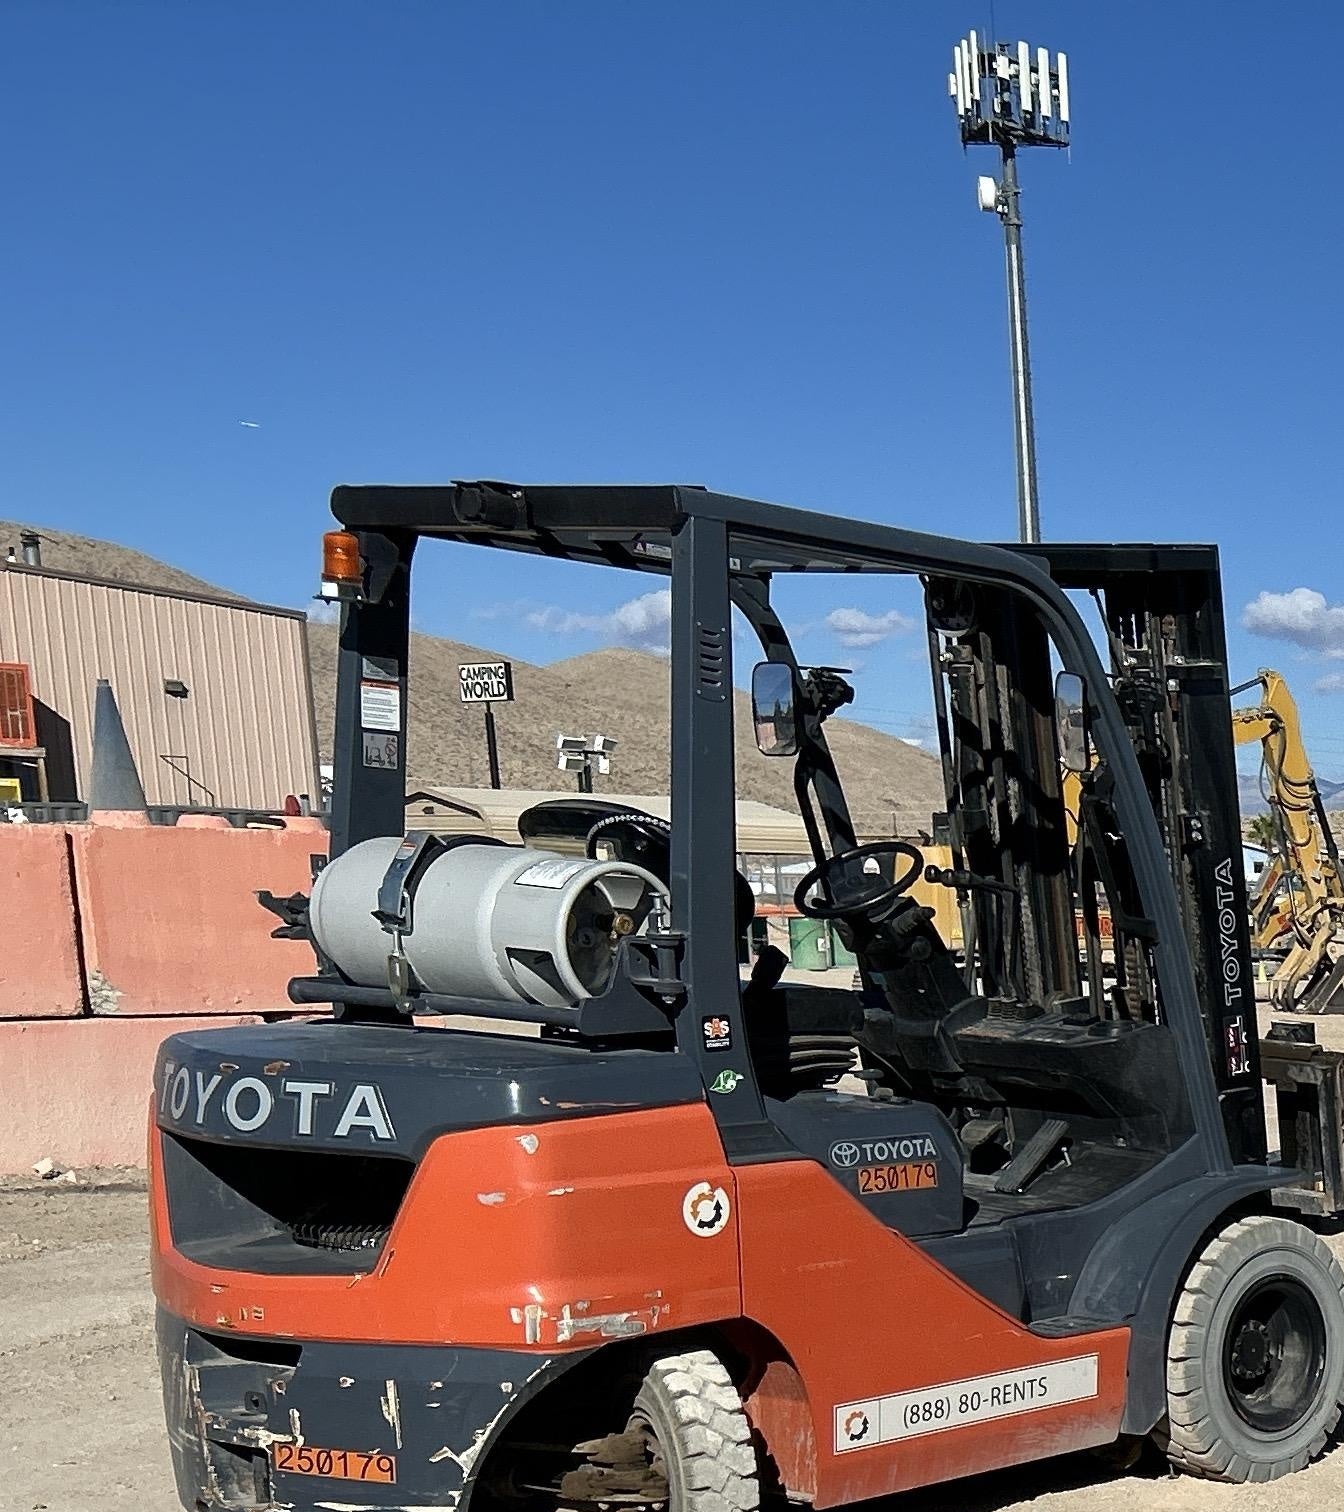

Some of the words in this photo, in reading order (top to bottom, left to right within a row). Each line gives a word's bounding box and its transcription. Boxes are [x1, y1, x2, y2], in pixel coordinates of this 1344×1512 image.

[459, 665, 505, 681] CAMPING
[461, 681, 507, 698] WORLD
[1214, 857, 1242, 1007] TOYOTA
[159, 1062, 396, 1140] TOYOTA
[861, 1139, 937, 1161] TOYOTA
[860, 1162, 937, 1192] 250179
[903, 1396, 951, 1429] (888)
[958, 1376, 1048, 1414] 80-RENTS
[277, 1445, 395, 1482] 250179
